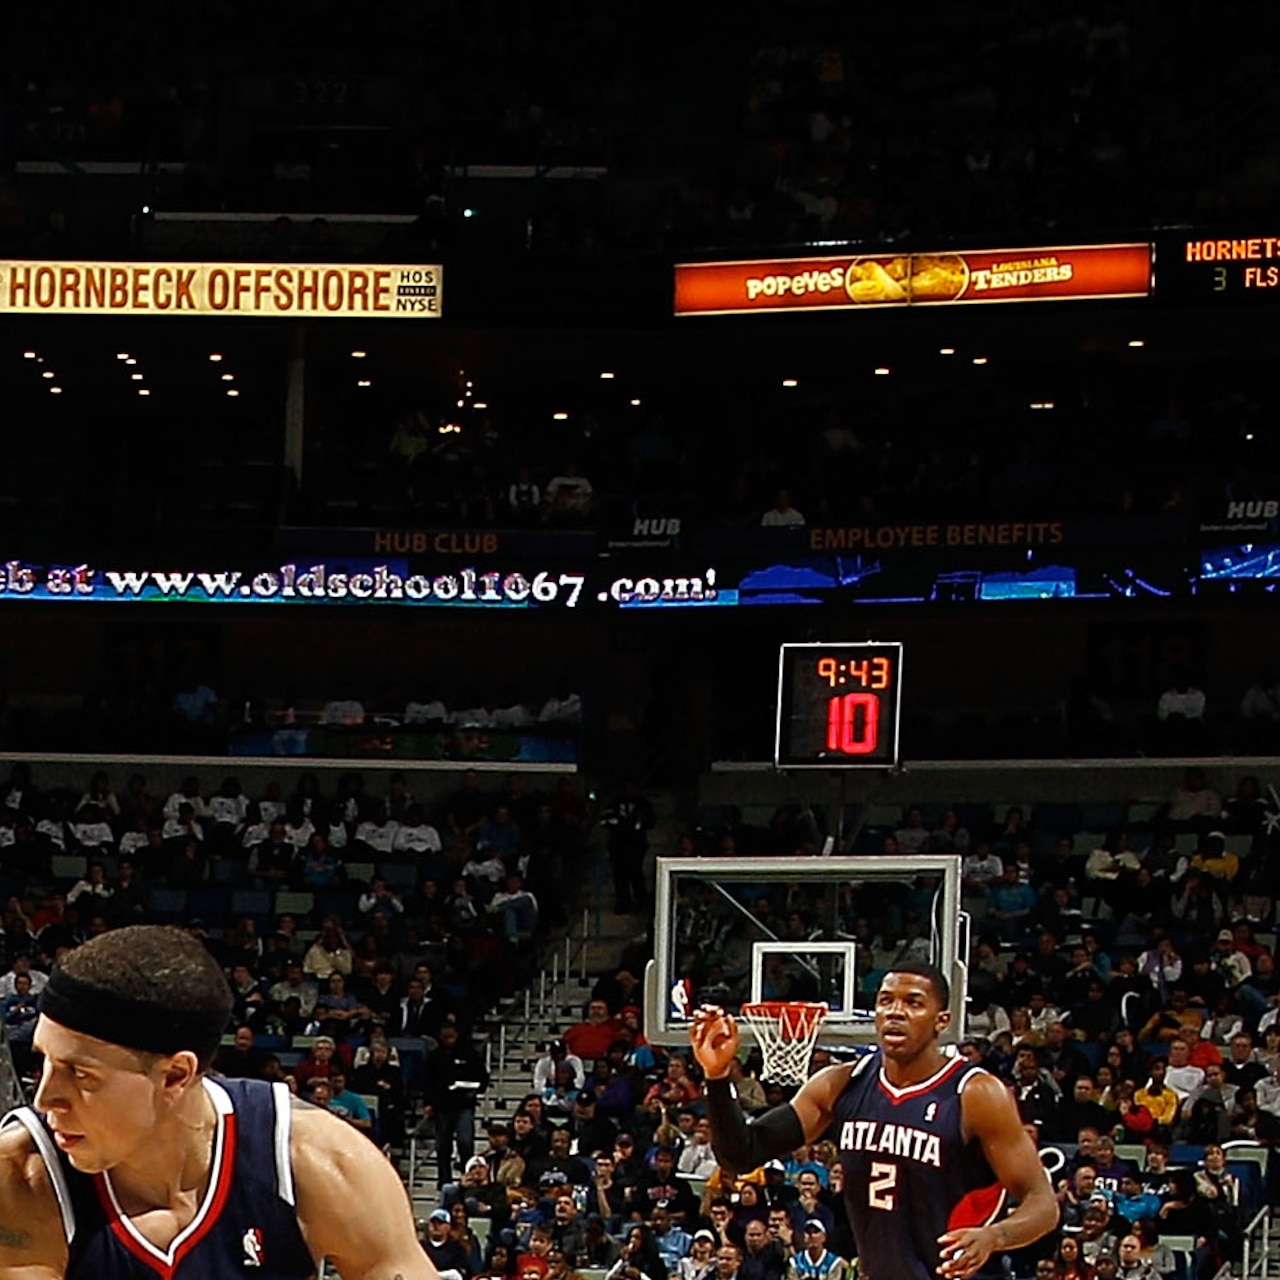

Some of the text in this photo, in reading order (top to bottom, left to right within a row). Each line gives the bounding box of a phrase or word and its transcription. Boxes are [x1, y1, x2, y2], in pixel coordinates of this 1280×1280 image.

[1186, 238, 1280, 262] HORNET
[9, 266, 391, 311] HORNBECK OFFSHORE
[400, 270, 433, 284] HOS
[396, 297, 438, 312] NYSE
[810, 521, 1065, 551] EMPLOYEE BENEFITS
[46, 563, 95, 594] at
[817, 656, 891, 690] 9:43
[826, 692, 881, 755] 10
[840, 1120, 941, 1168] ATLANTA
[868, 1161, 897, 1211] 2
